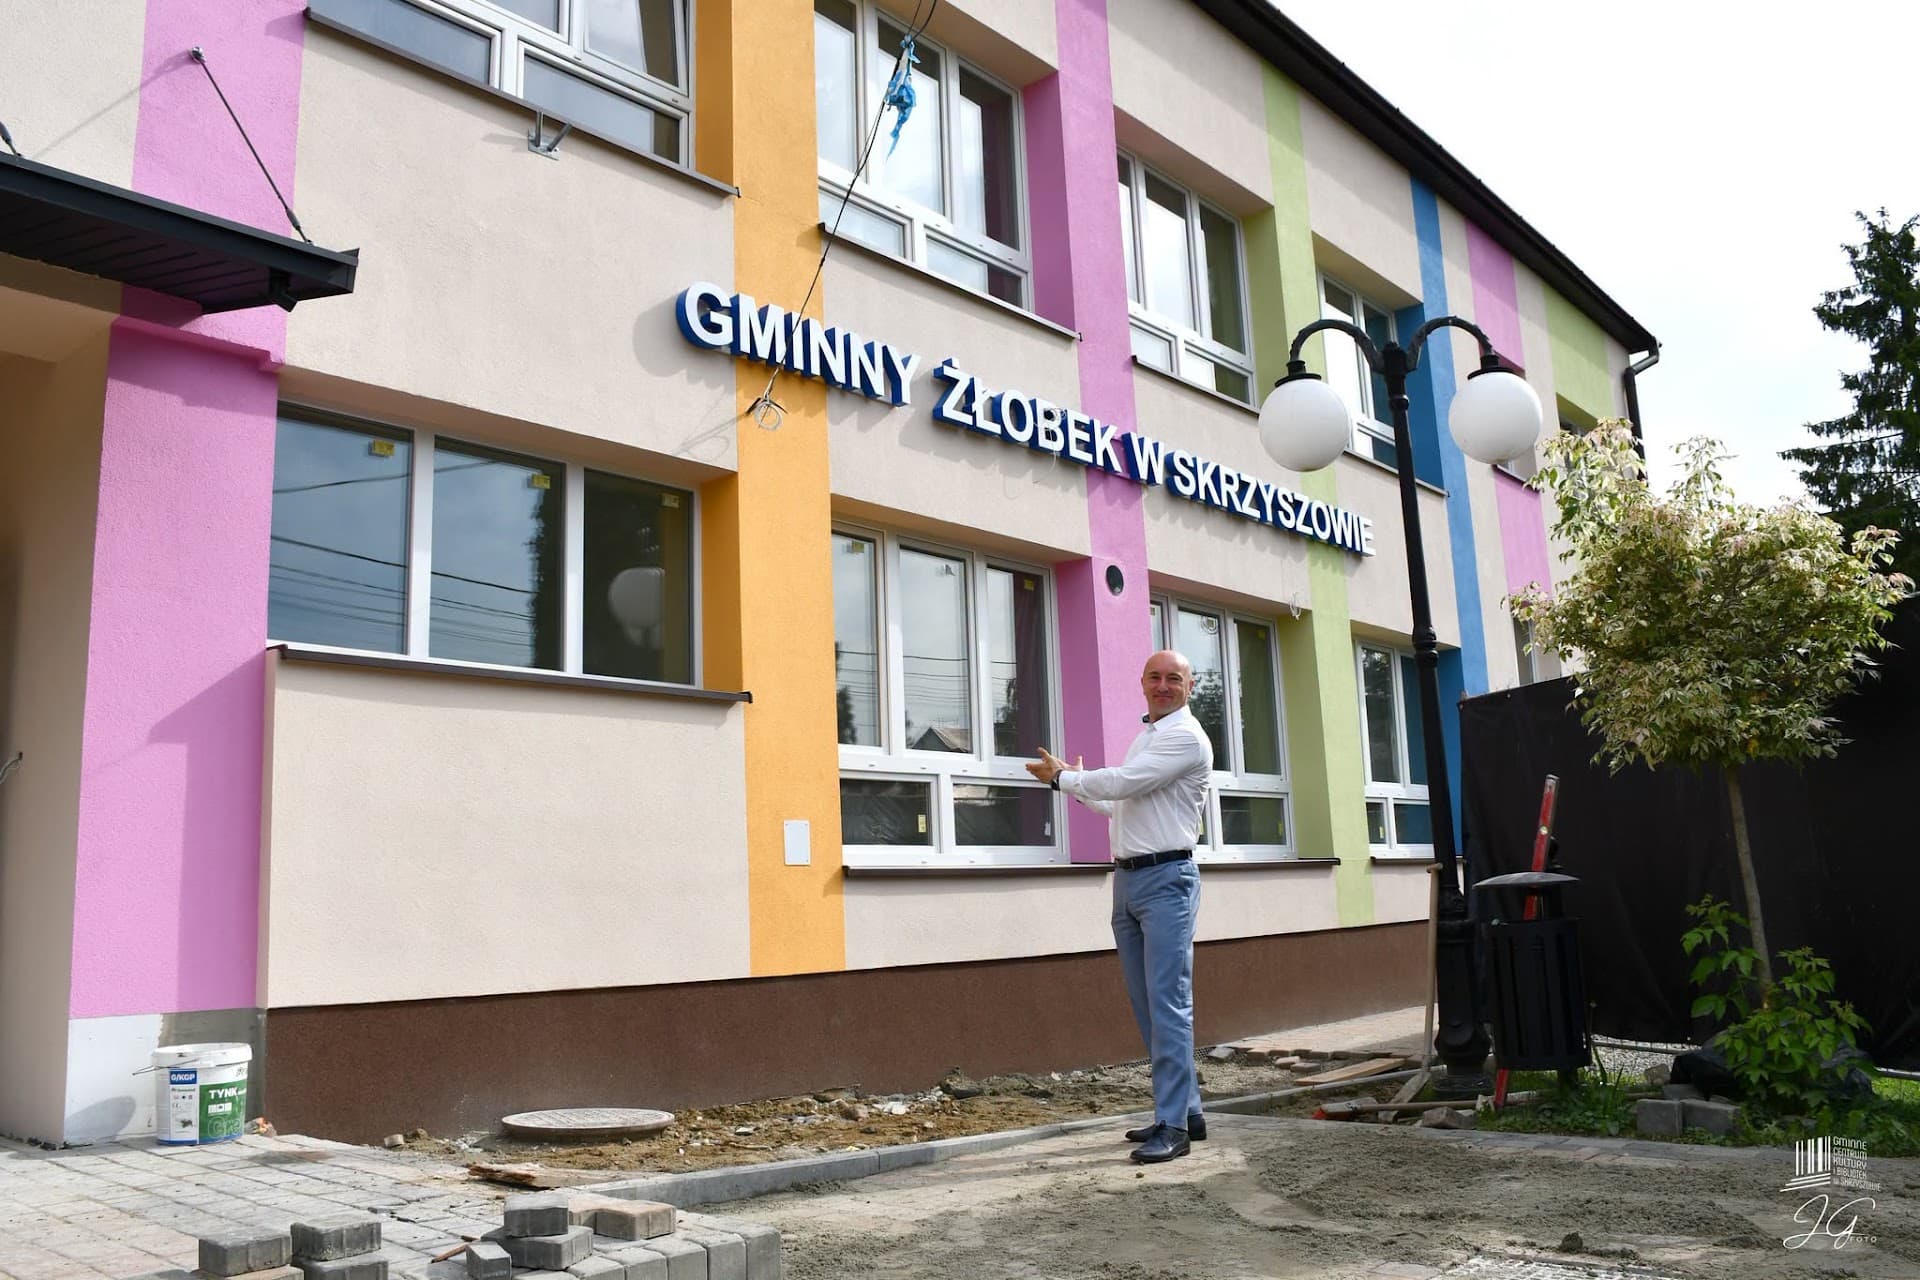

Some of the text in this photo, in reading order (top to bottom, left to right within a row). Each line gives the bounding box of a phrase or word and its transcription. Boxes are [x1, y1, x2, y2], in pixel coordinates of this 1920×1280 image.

[678, 281, 1376, 557] GMINNY ŻŁOBEK W SKRZYSZOWIE
[208, 1087, 238, 1100] TYNK
